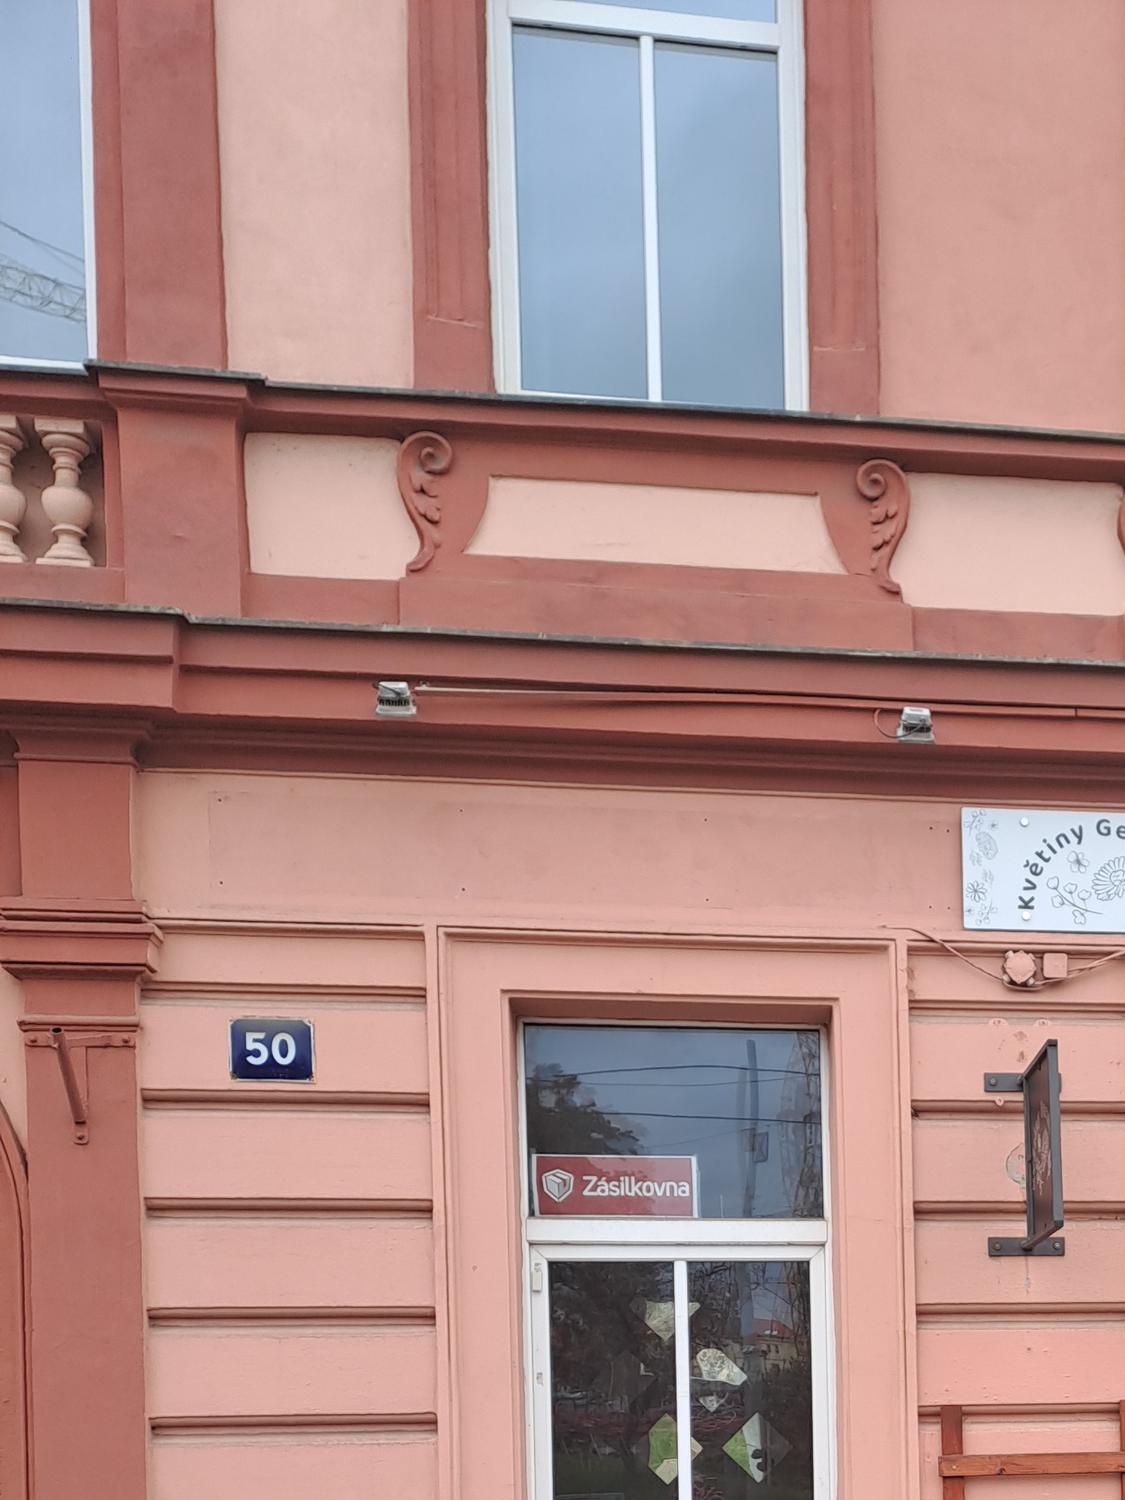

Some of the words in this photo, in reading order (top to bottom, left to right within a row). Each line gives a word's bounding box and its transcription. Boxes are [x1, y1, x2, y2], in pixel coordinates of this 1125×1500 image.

[1017, 824, 1084, 910] Květiny
[245, 1031, 296, 1066] 50
[582, 1175, 690, 1197] Zásilkovna
